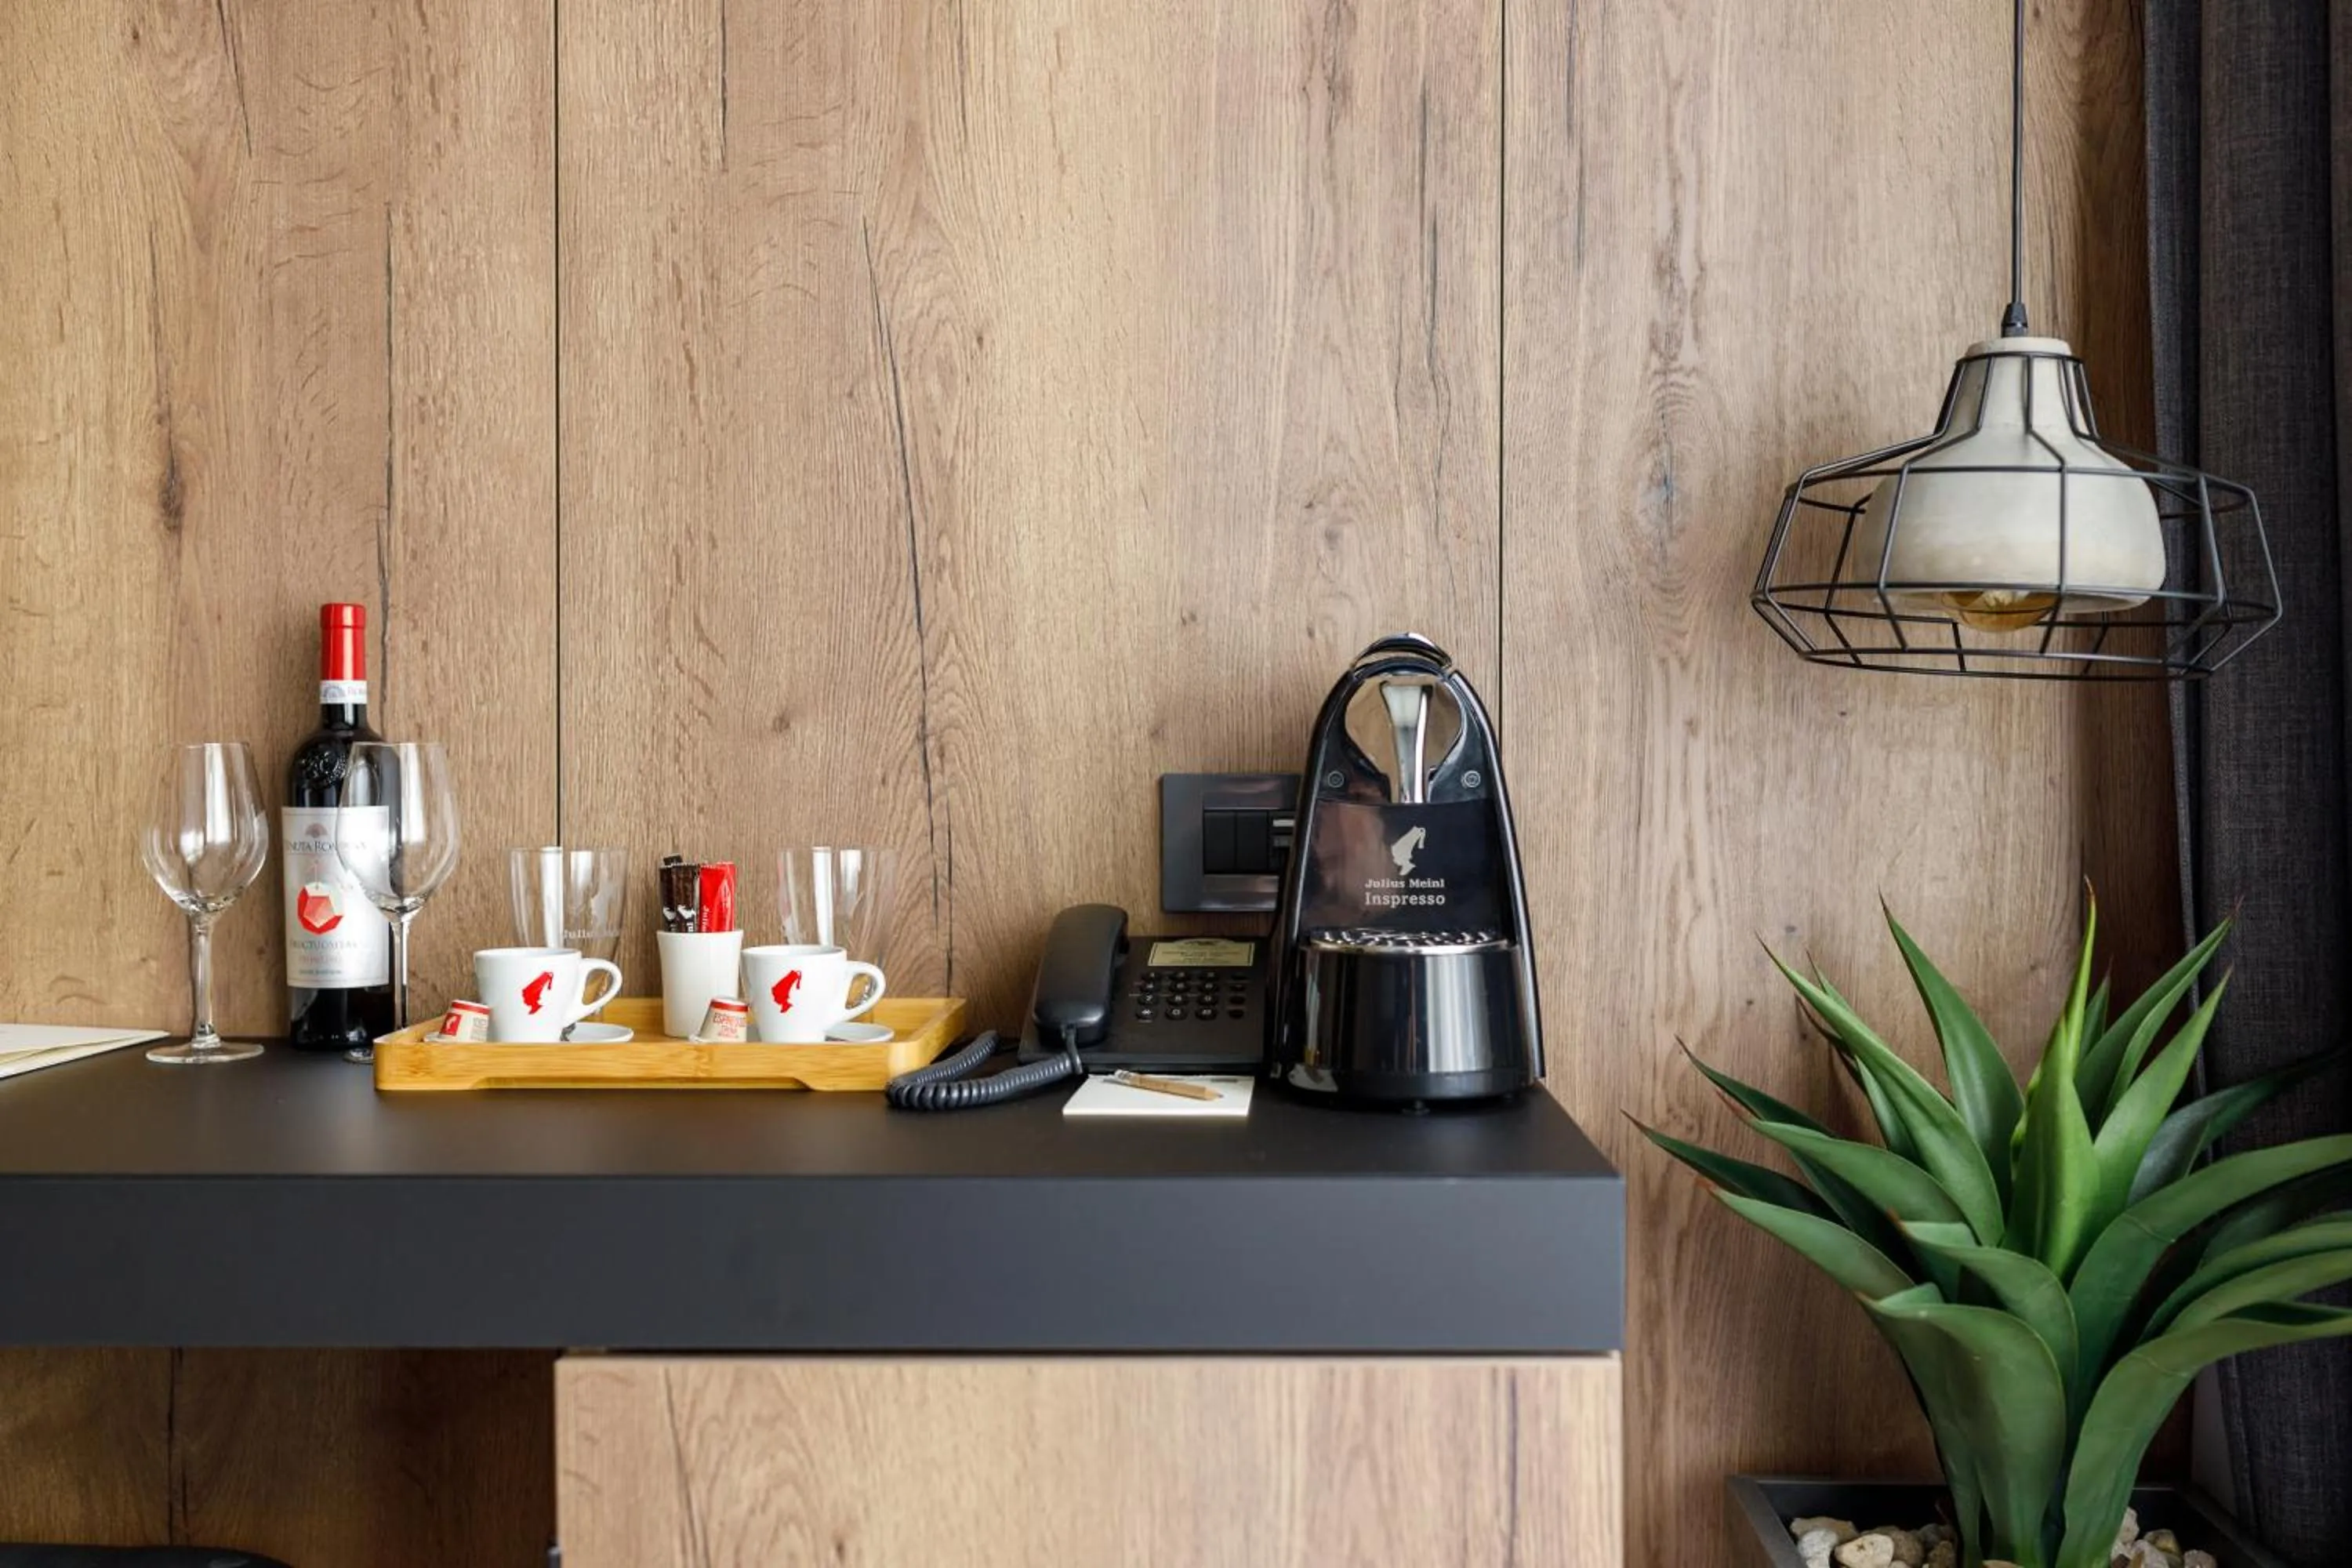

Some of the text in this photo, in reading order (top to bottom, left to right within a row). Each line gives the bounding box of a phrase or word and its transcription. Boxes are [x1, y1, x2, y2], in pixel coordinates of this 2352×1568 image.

[1365, 878, 1445, 888] Julius Meinl
[1365, 891, 1445, 908] Inspresso
